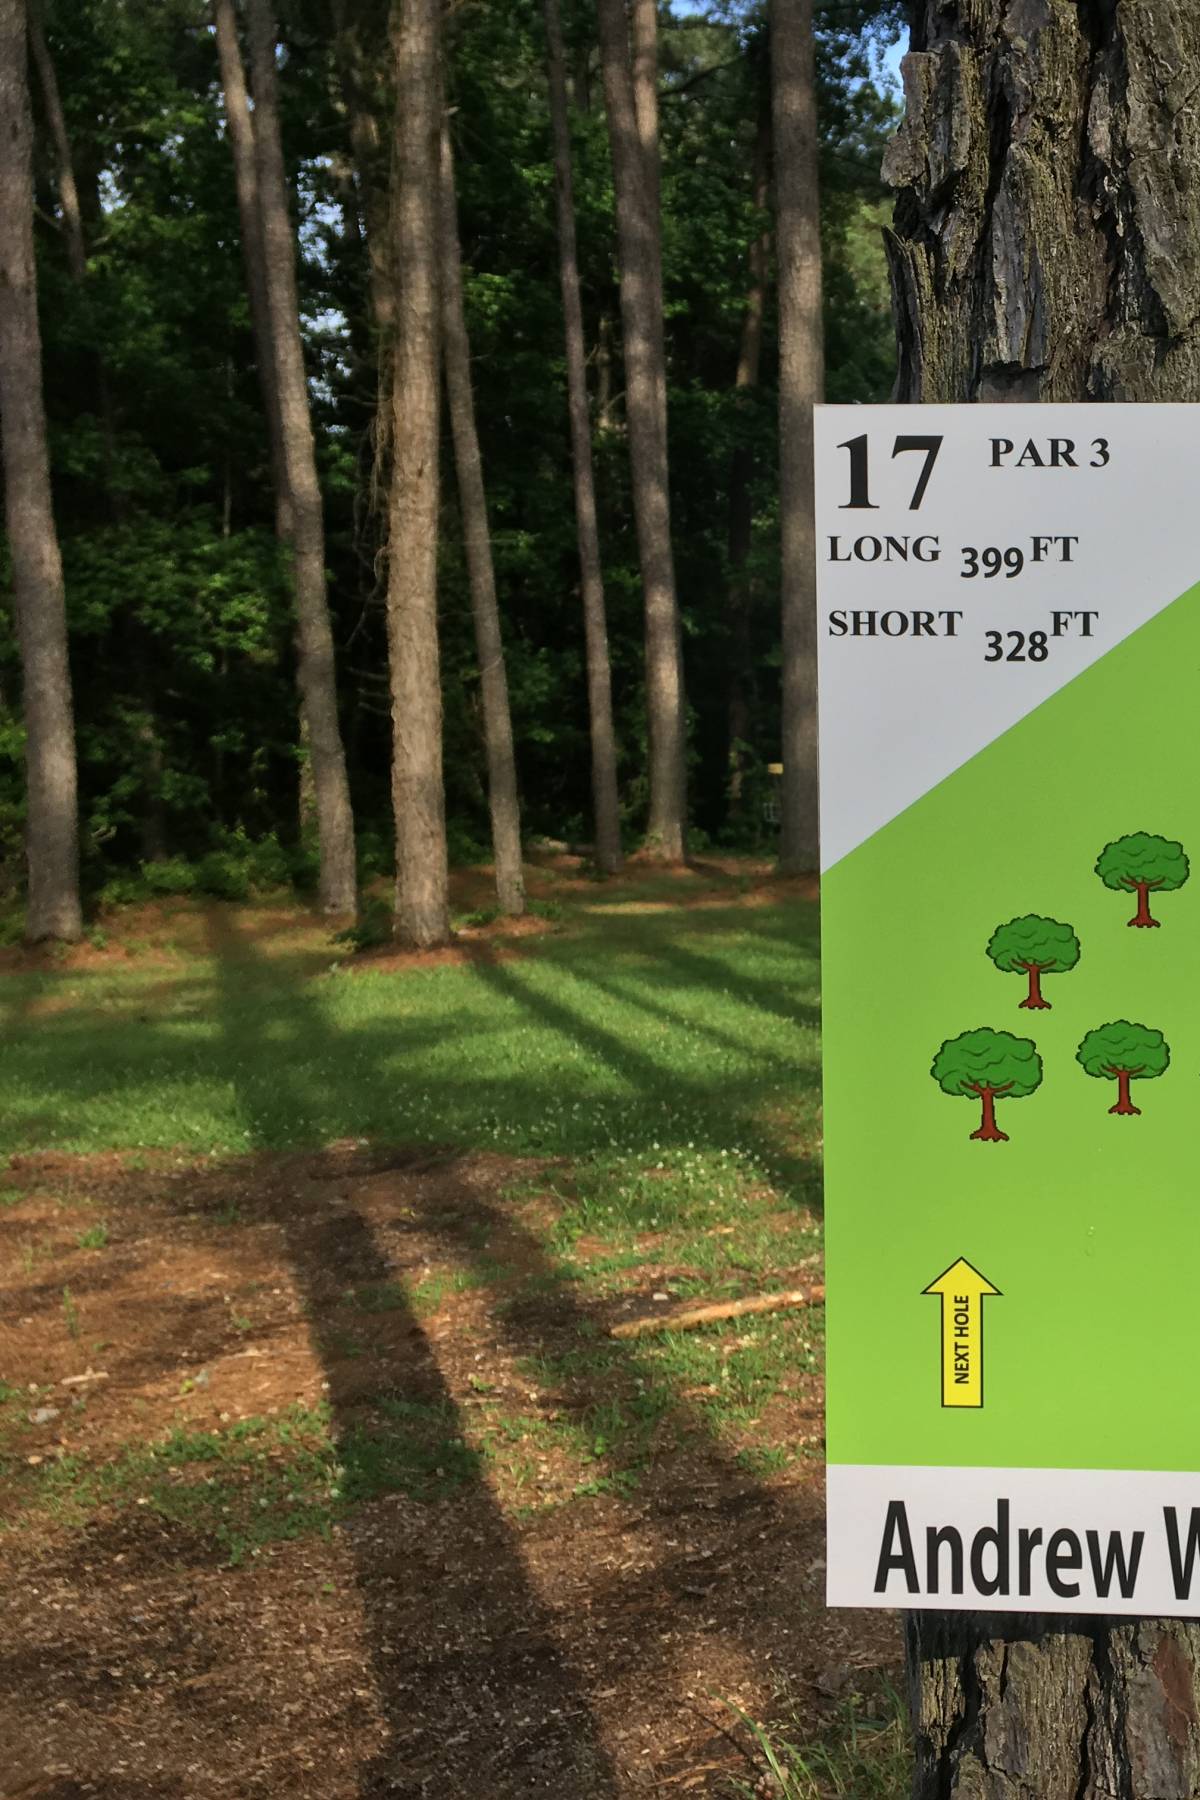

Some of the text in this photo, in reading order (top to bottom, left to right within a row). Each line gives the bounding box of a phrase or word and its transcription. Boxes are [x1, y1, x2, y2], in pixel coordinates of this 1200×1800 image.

[837, 434, 943, 510] 17
[988, 438, 1110, 468] PAR 3
[827, 535, 1079, 579] LONG 399 FT
[828, 610, 1099, 662] SHORT 328 FT
[954, 1295, 970, 1384] NEXT HOLE
[873, 1498, 1146, 1599] Andrew
